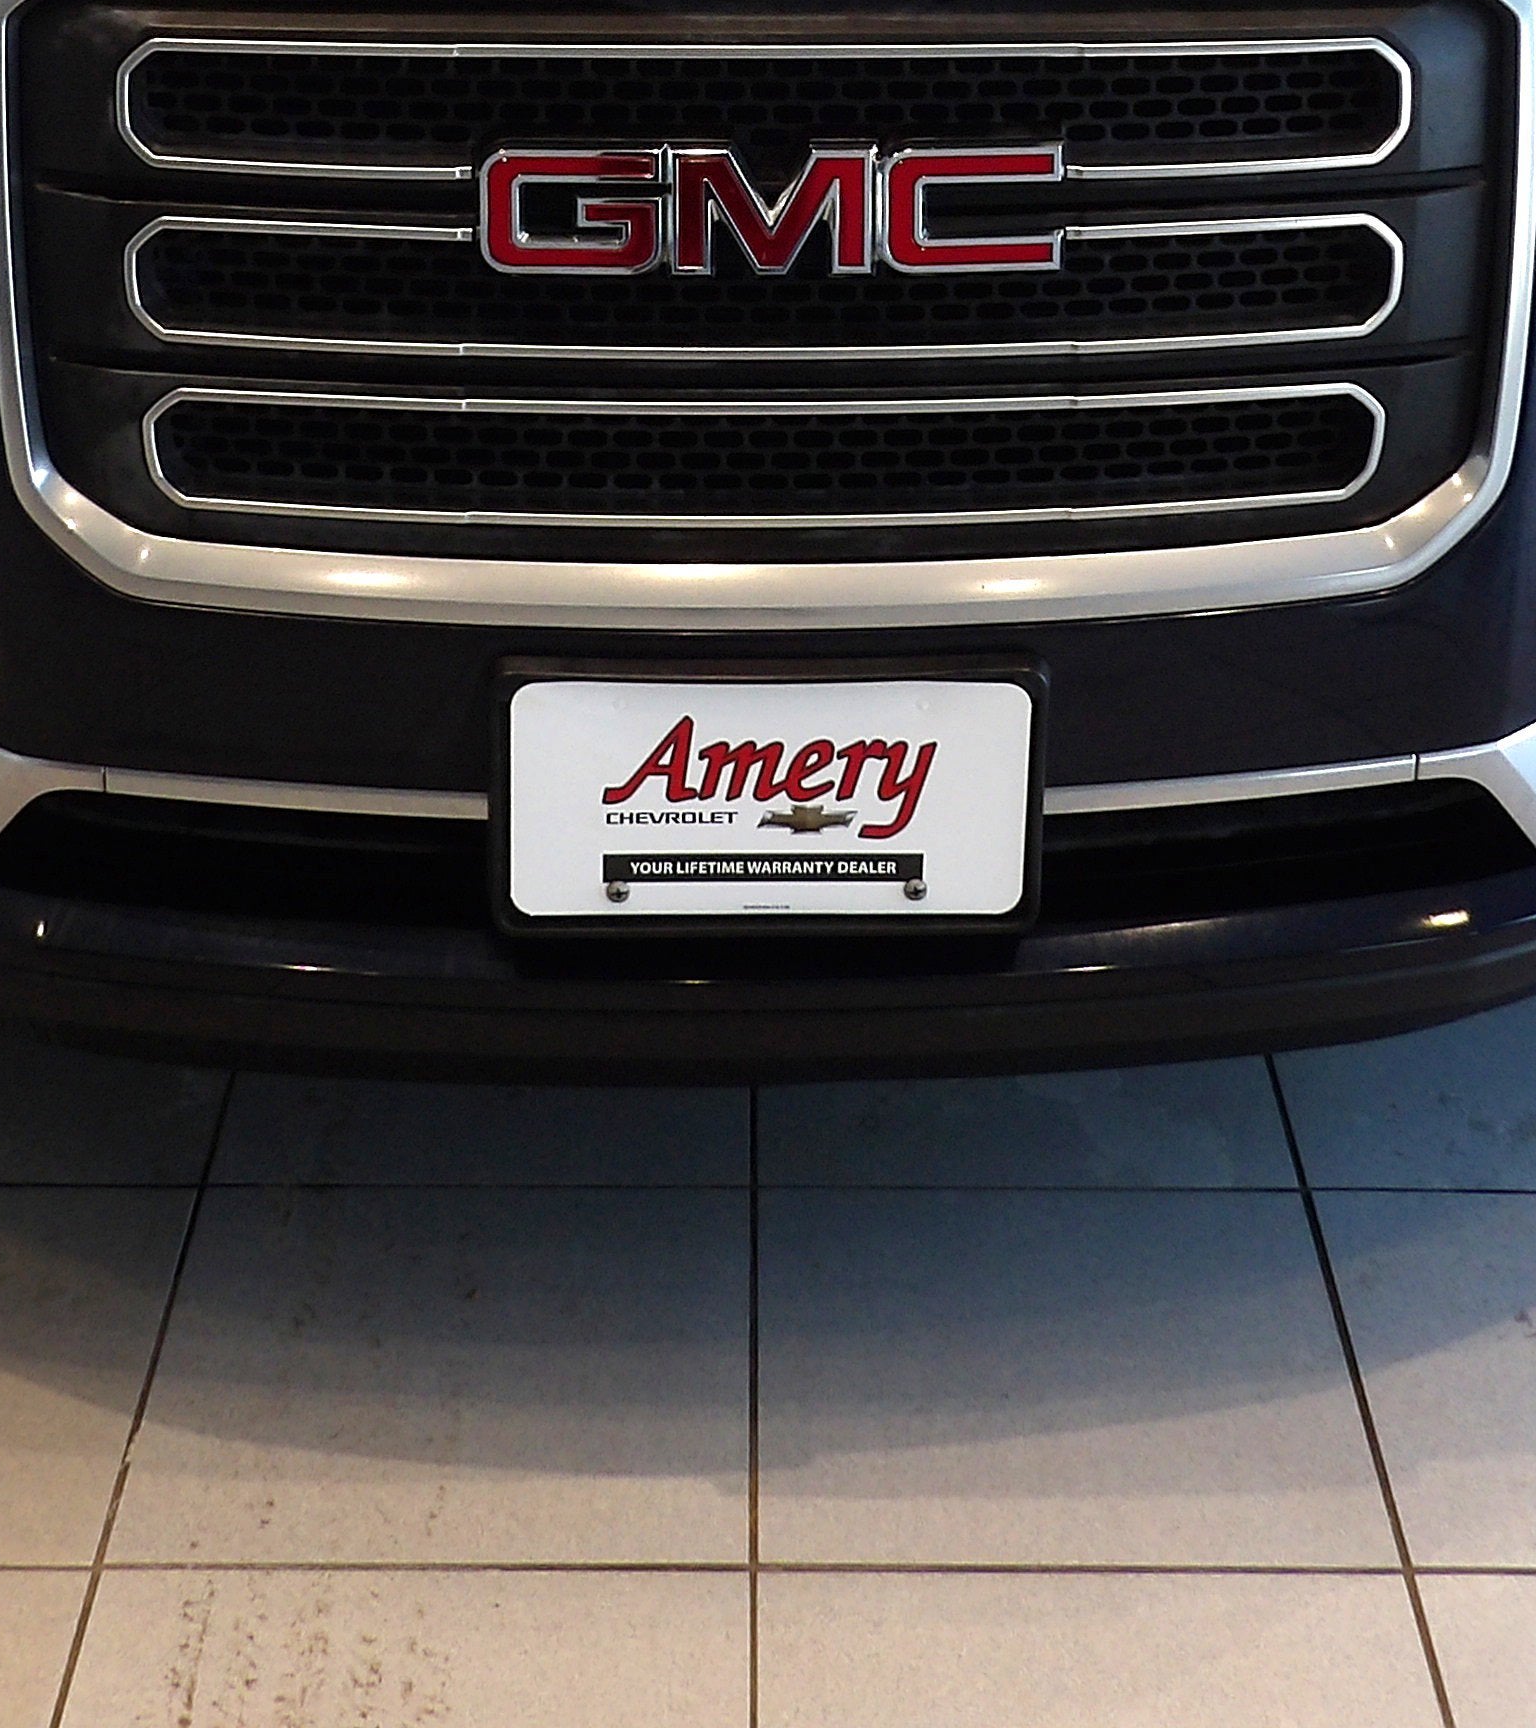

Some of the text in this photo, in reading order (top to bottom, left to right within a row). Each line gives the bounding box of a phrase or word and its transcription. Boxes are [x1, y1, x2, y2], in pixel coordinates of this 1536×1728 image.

[479, 143, 1065, 277] GMC
[602, 714, 938, 840] Amery
[605, 810, 739, 825] CHEVROLET
[629, 860, 897, 875] YOUR LIFETIME WARRANTY DEALER
